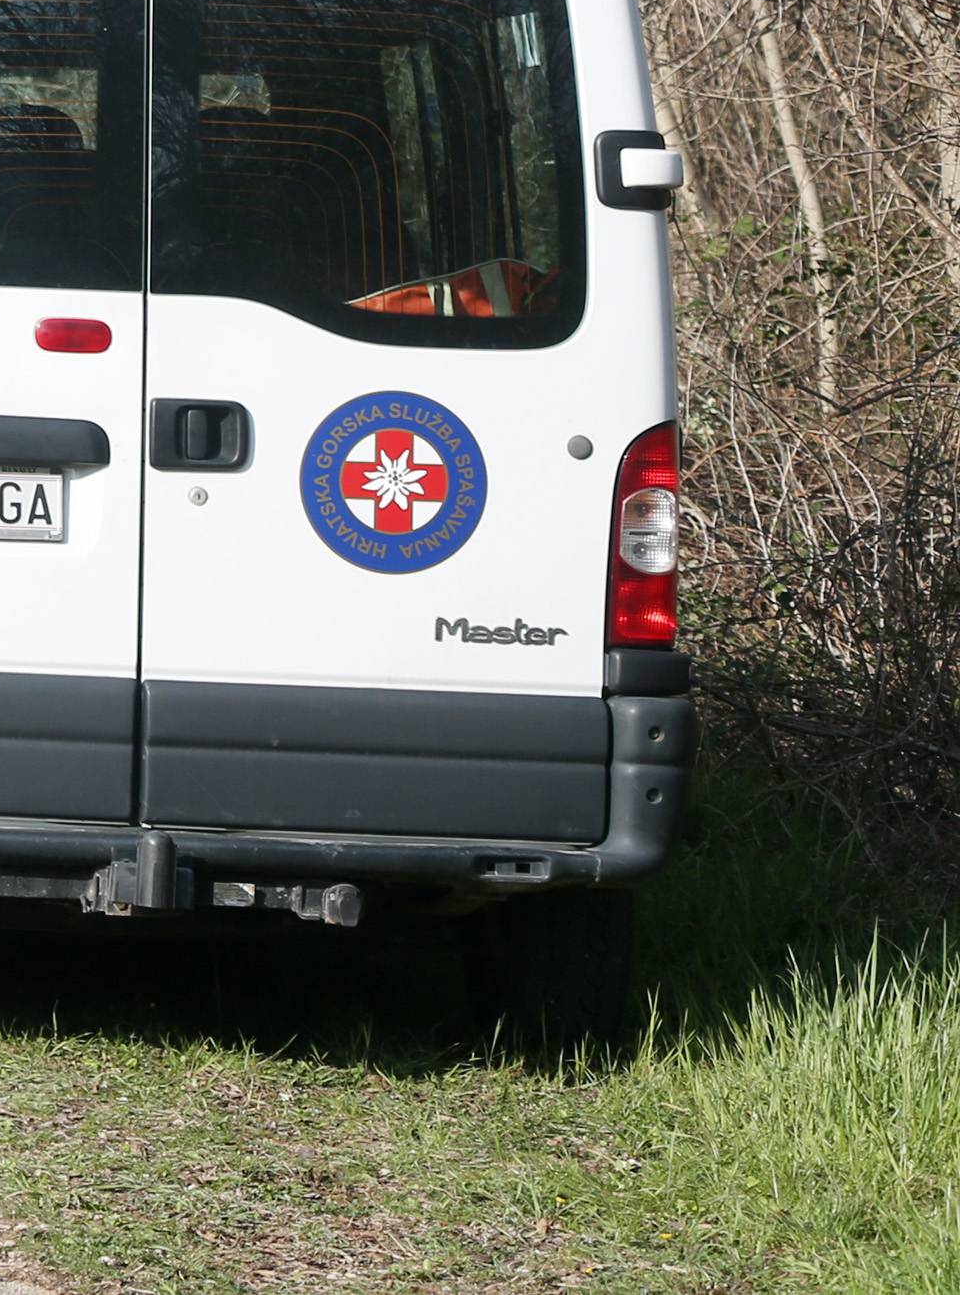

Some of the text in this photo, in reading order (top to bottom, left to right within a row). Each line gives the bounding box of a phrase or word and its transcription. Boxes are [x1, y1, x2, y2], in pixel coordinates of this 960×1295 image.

[316, 405, 385, 469] GORSKA
[388, 402, 463, 453] SLUŽBA
[313, 474, 388, 559] HRVATSKA
[434, 616, 569, 646] Master
